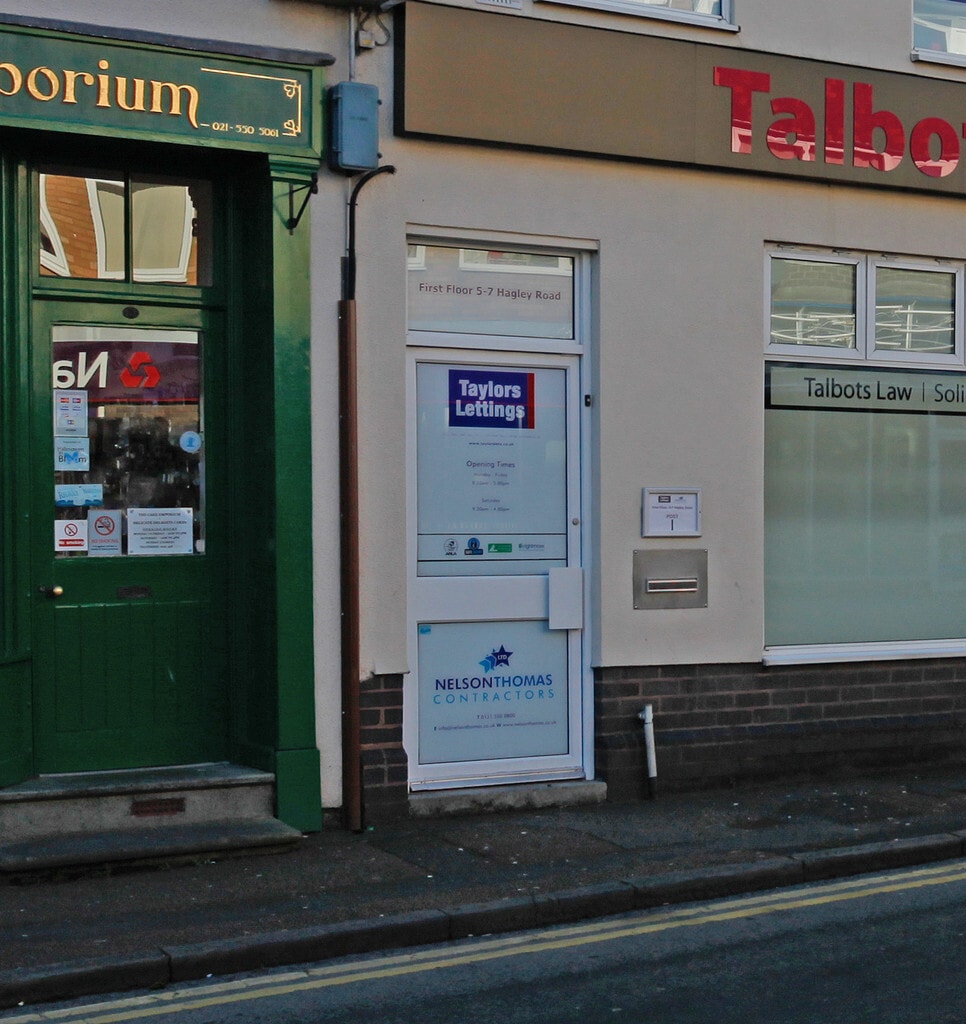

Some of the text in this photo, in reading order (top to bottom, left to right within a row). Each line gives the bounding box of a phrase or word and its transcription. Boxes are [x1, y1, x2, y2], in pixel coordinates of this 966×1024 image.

[419, 283, 561, 301] First Floor 5-7 Hagley Road
[458, 379, 521, 400] Taylors
[804, 377, 871, 400] Talbots
[876, 381, 913, 401] Law
[455, 399, 525, 421] Lettings
[466, 460, 495, 468] Opening
[436, 674, 553, 690] NELSONTHOMAS
[433, 689, 554, 704] CONTRACTORS
